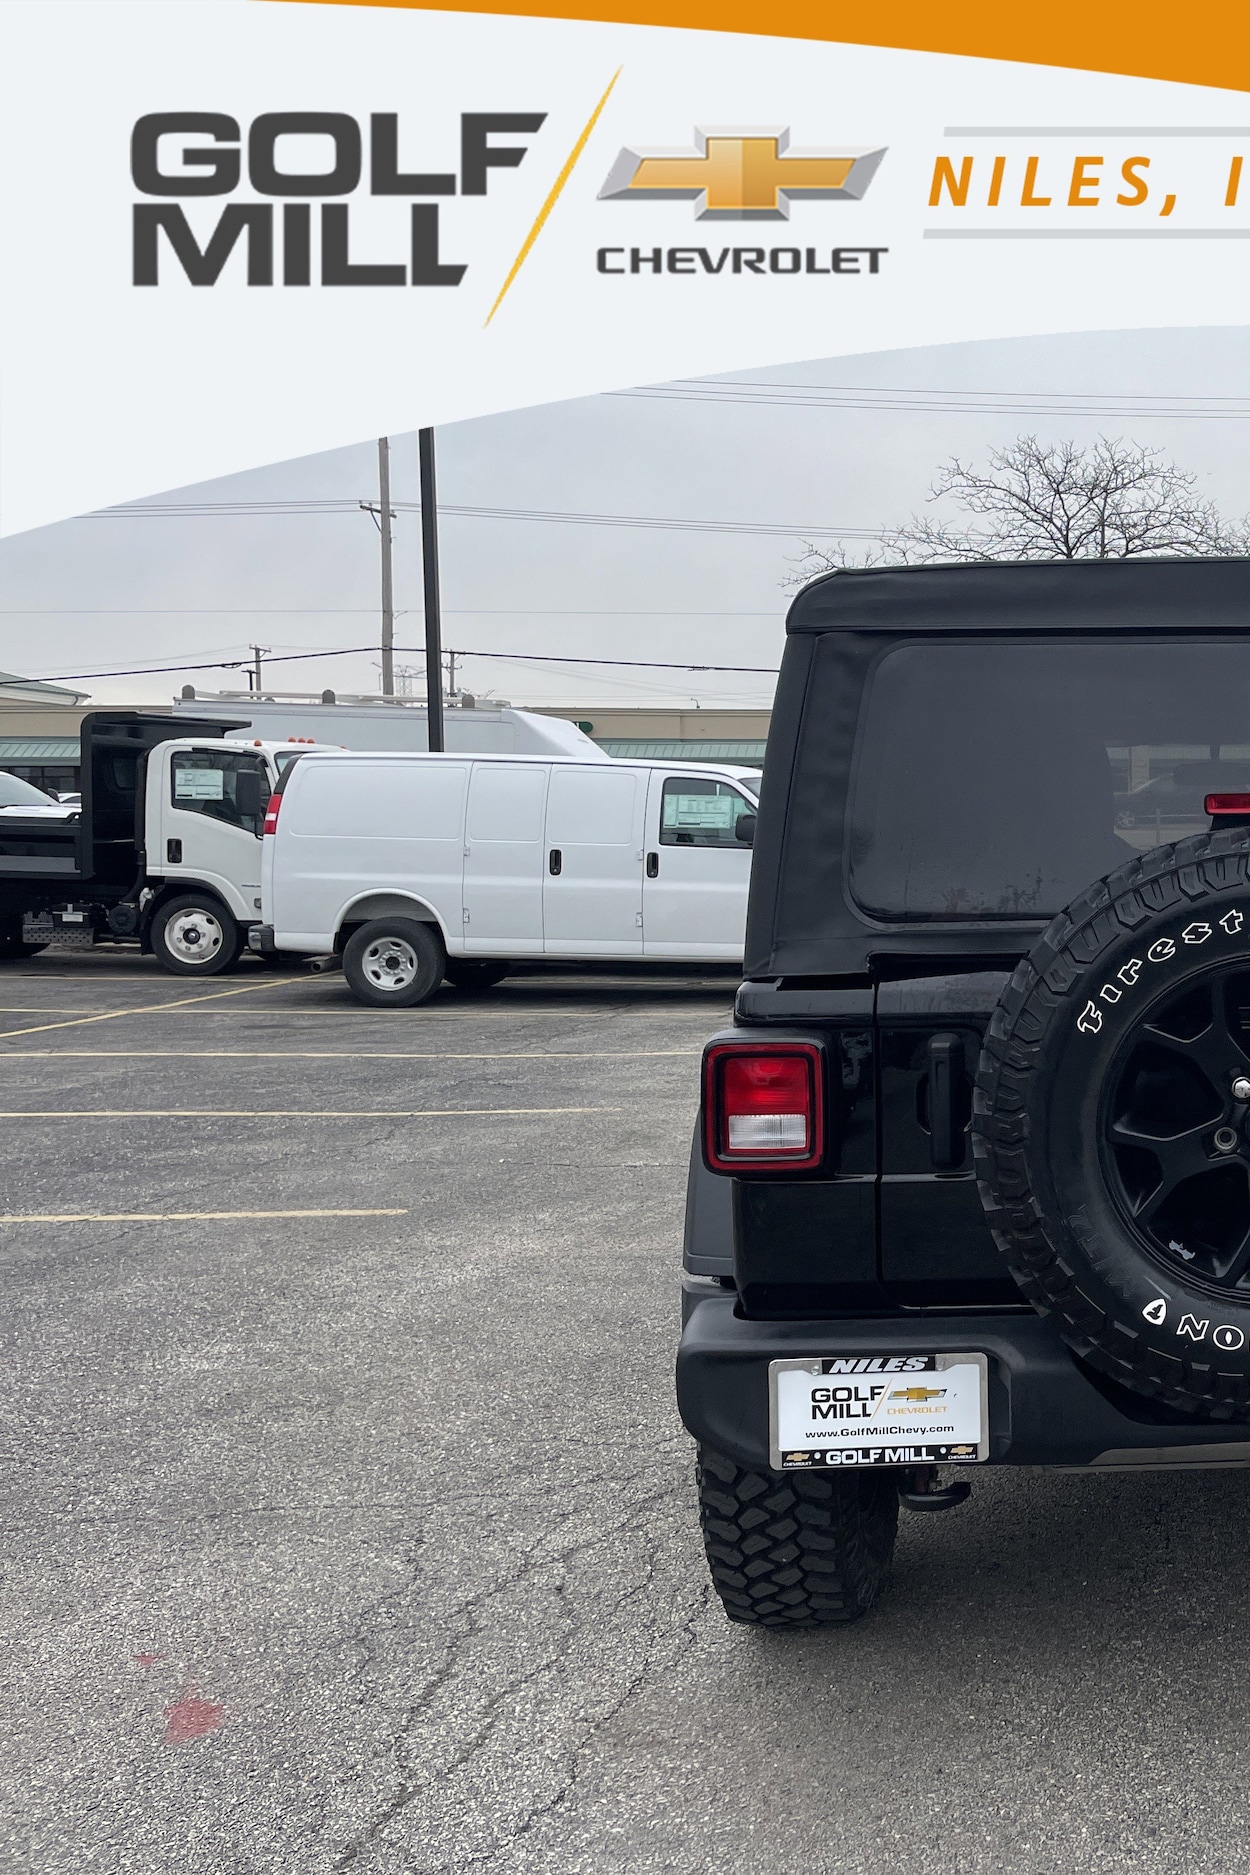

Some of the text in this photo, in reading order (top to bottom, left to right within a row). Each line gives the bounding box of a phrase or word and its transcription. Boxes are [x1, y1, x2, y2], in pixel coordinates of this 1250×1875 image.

[829, 1357, 928, 1374] NILES
[810, 1385, 886, 1403] GOLF
[811, 1402, 872, 1420] MILL
[887, 1406, 949, 1415] CHEVROLET
[805, 1425, 955, 1438] www.GolfMillChevy.com
[825, 1447, 935, 1465] GOLF MILL
